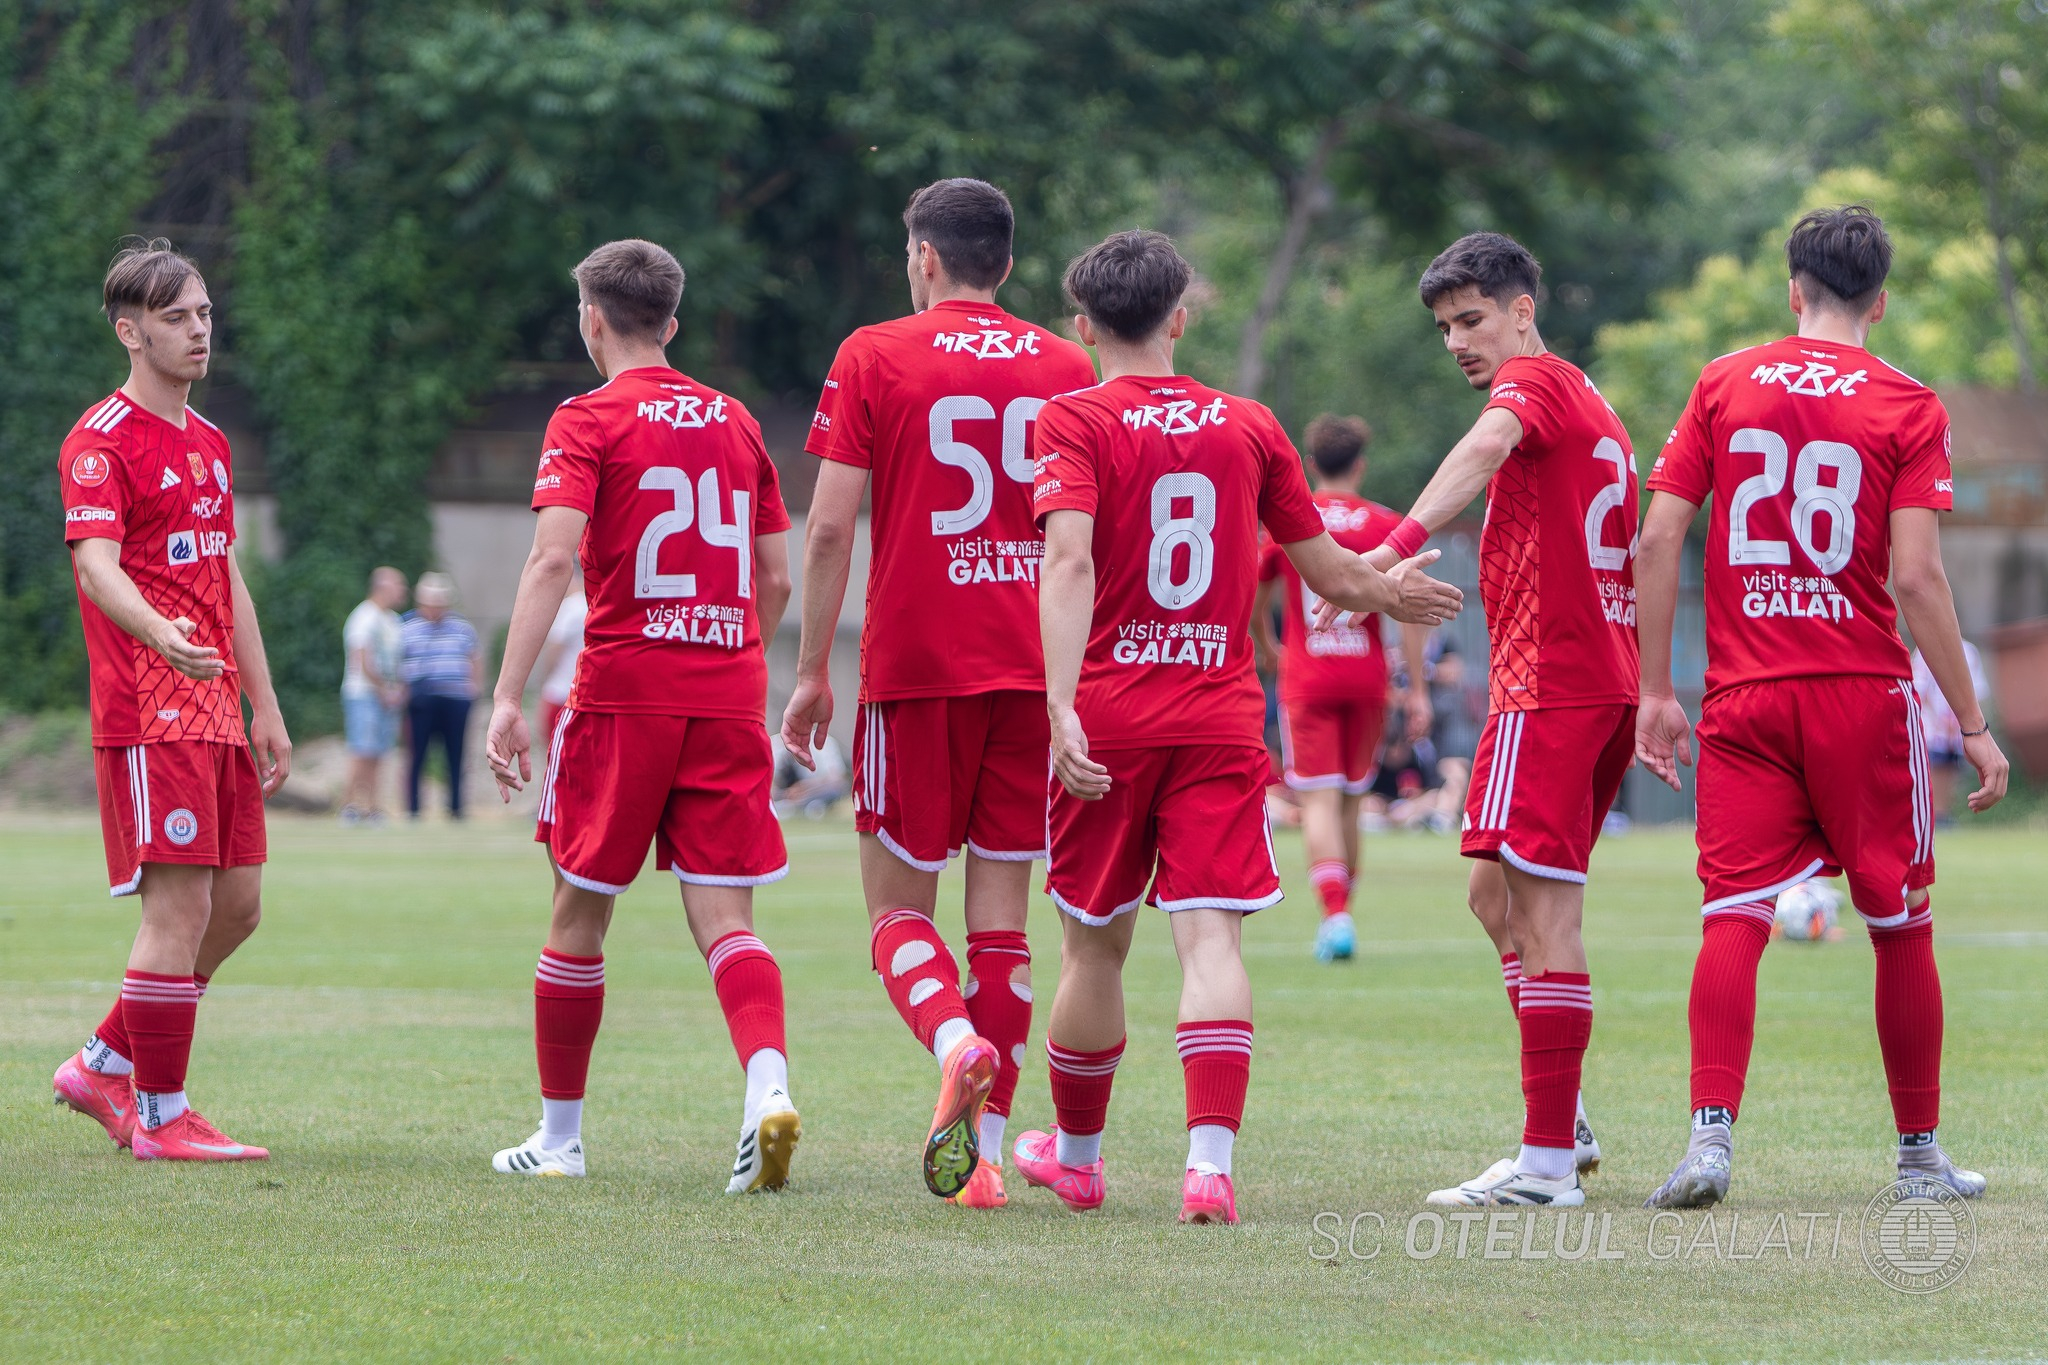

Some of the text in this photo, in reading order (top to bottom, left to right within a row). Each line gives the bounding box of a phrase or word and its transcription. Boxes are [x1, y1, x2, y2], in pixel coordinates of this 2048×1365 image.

[1584, 436, 1639, 572] 2
[1728, 427, 1862, 576] 28
[634, 466, 750, 600] 24
[946, 537, 993, 559] visit
[1147, 472, 1216, 611] 8
[1742, 570, 1788, 592] visit
[646, 604, 690, 623] visit
[1601, 597, 1636, 628] GALA
[1118, 619, 1164, 640] visit
